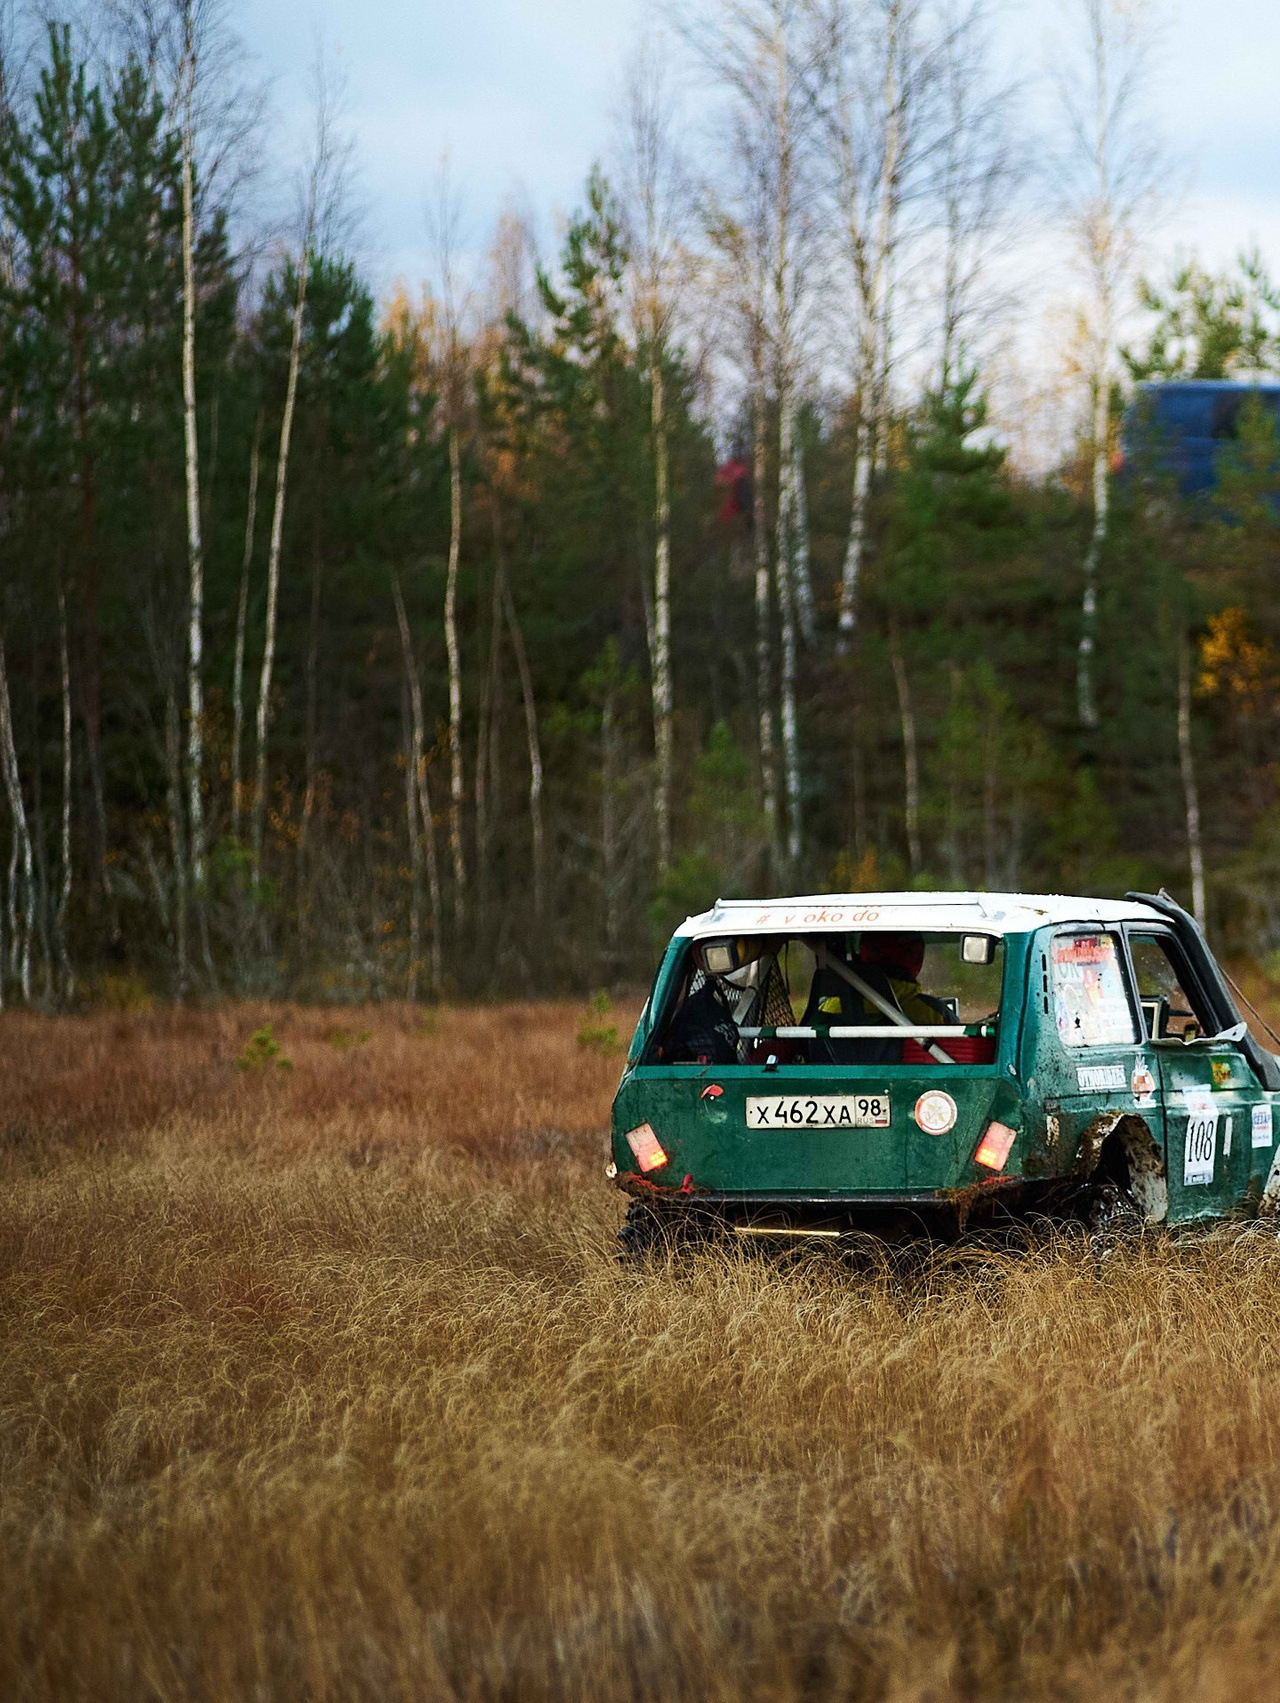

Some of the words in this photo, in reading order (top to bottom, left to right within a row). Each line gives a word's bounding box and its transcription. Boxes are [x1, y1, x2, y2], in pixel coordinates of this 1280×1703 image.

[804, 910, 843, 923] oko
[853, 909, 880, 922] do
[858, 1099, 881, 1117] 98
[857, 1117, 875, 1125] RUS
[1188, 1120, 1214, 1162] 108
